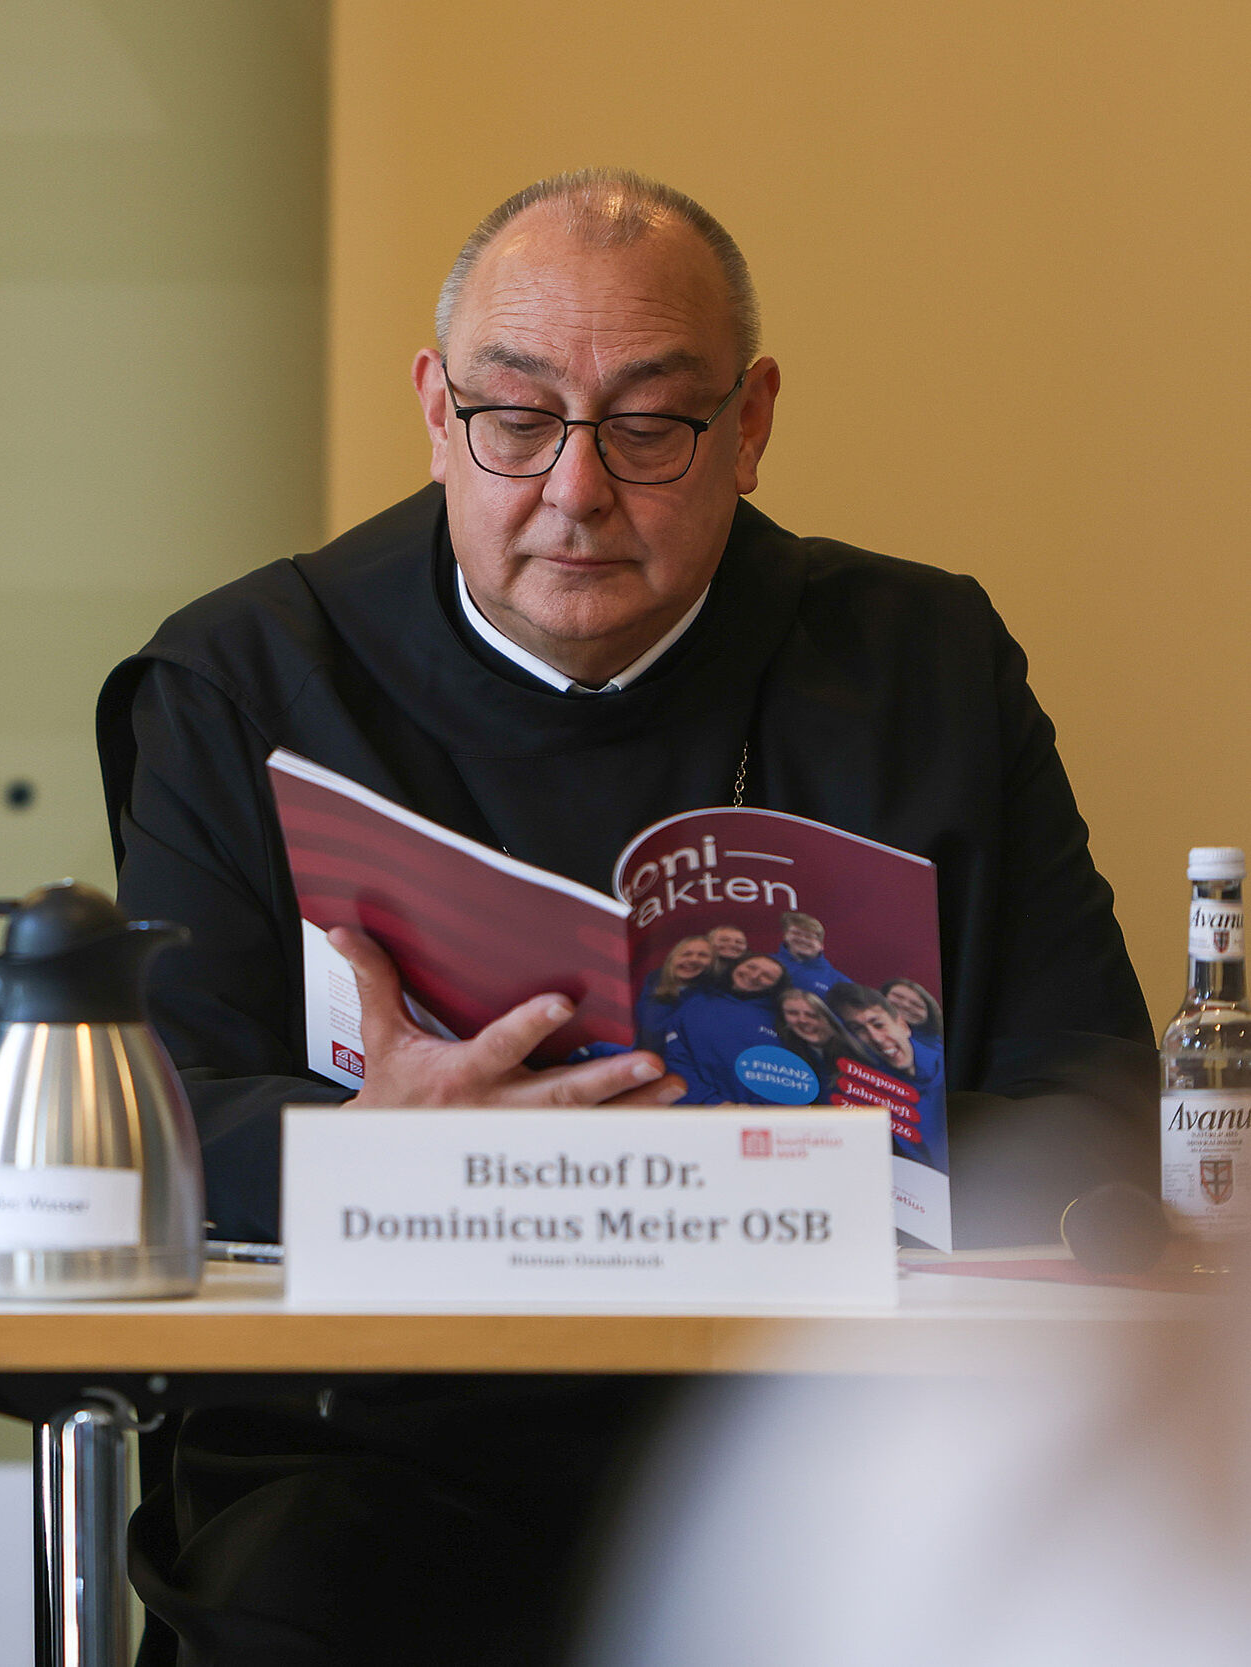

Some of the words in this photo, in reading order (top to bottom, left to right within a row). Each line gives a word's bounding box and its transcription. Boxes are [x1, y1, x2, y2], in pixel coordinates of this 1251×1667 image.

[634, 871, 798, 929] akten
[744, 1070, 811, 1093] BERICHT
[846, 1062, 910, 1097] Diaspora-
[845, 1082, 911, 1119] Jahresheft
[463, 1152, 634, 1190] Bischof
[644, 1154, 706, 1190] Dr.
[340, 1207, 583, 1243] Dominicus
[596, 1208, 729, 1243] Meier
[741, 1209, 833, 1245] OSB
